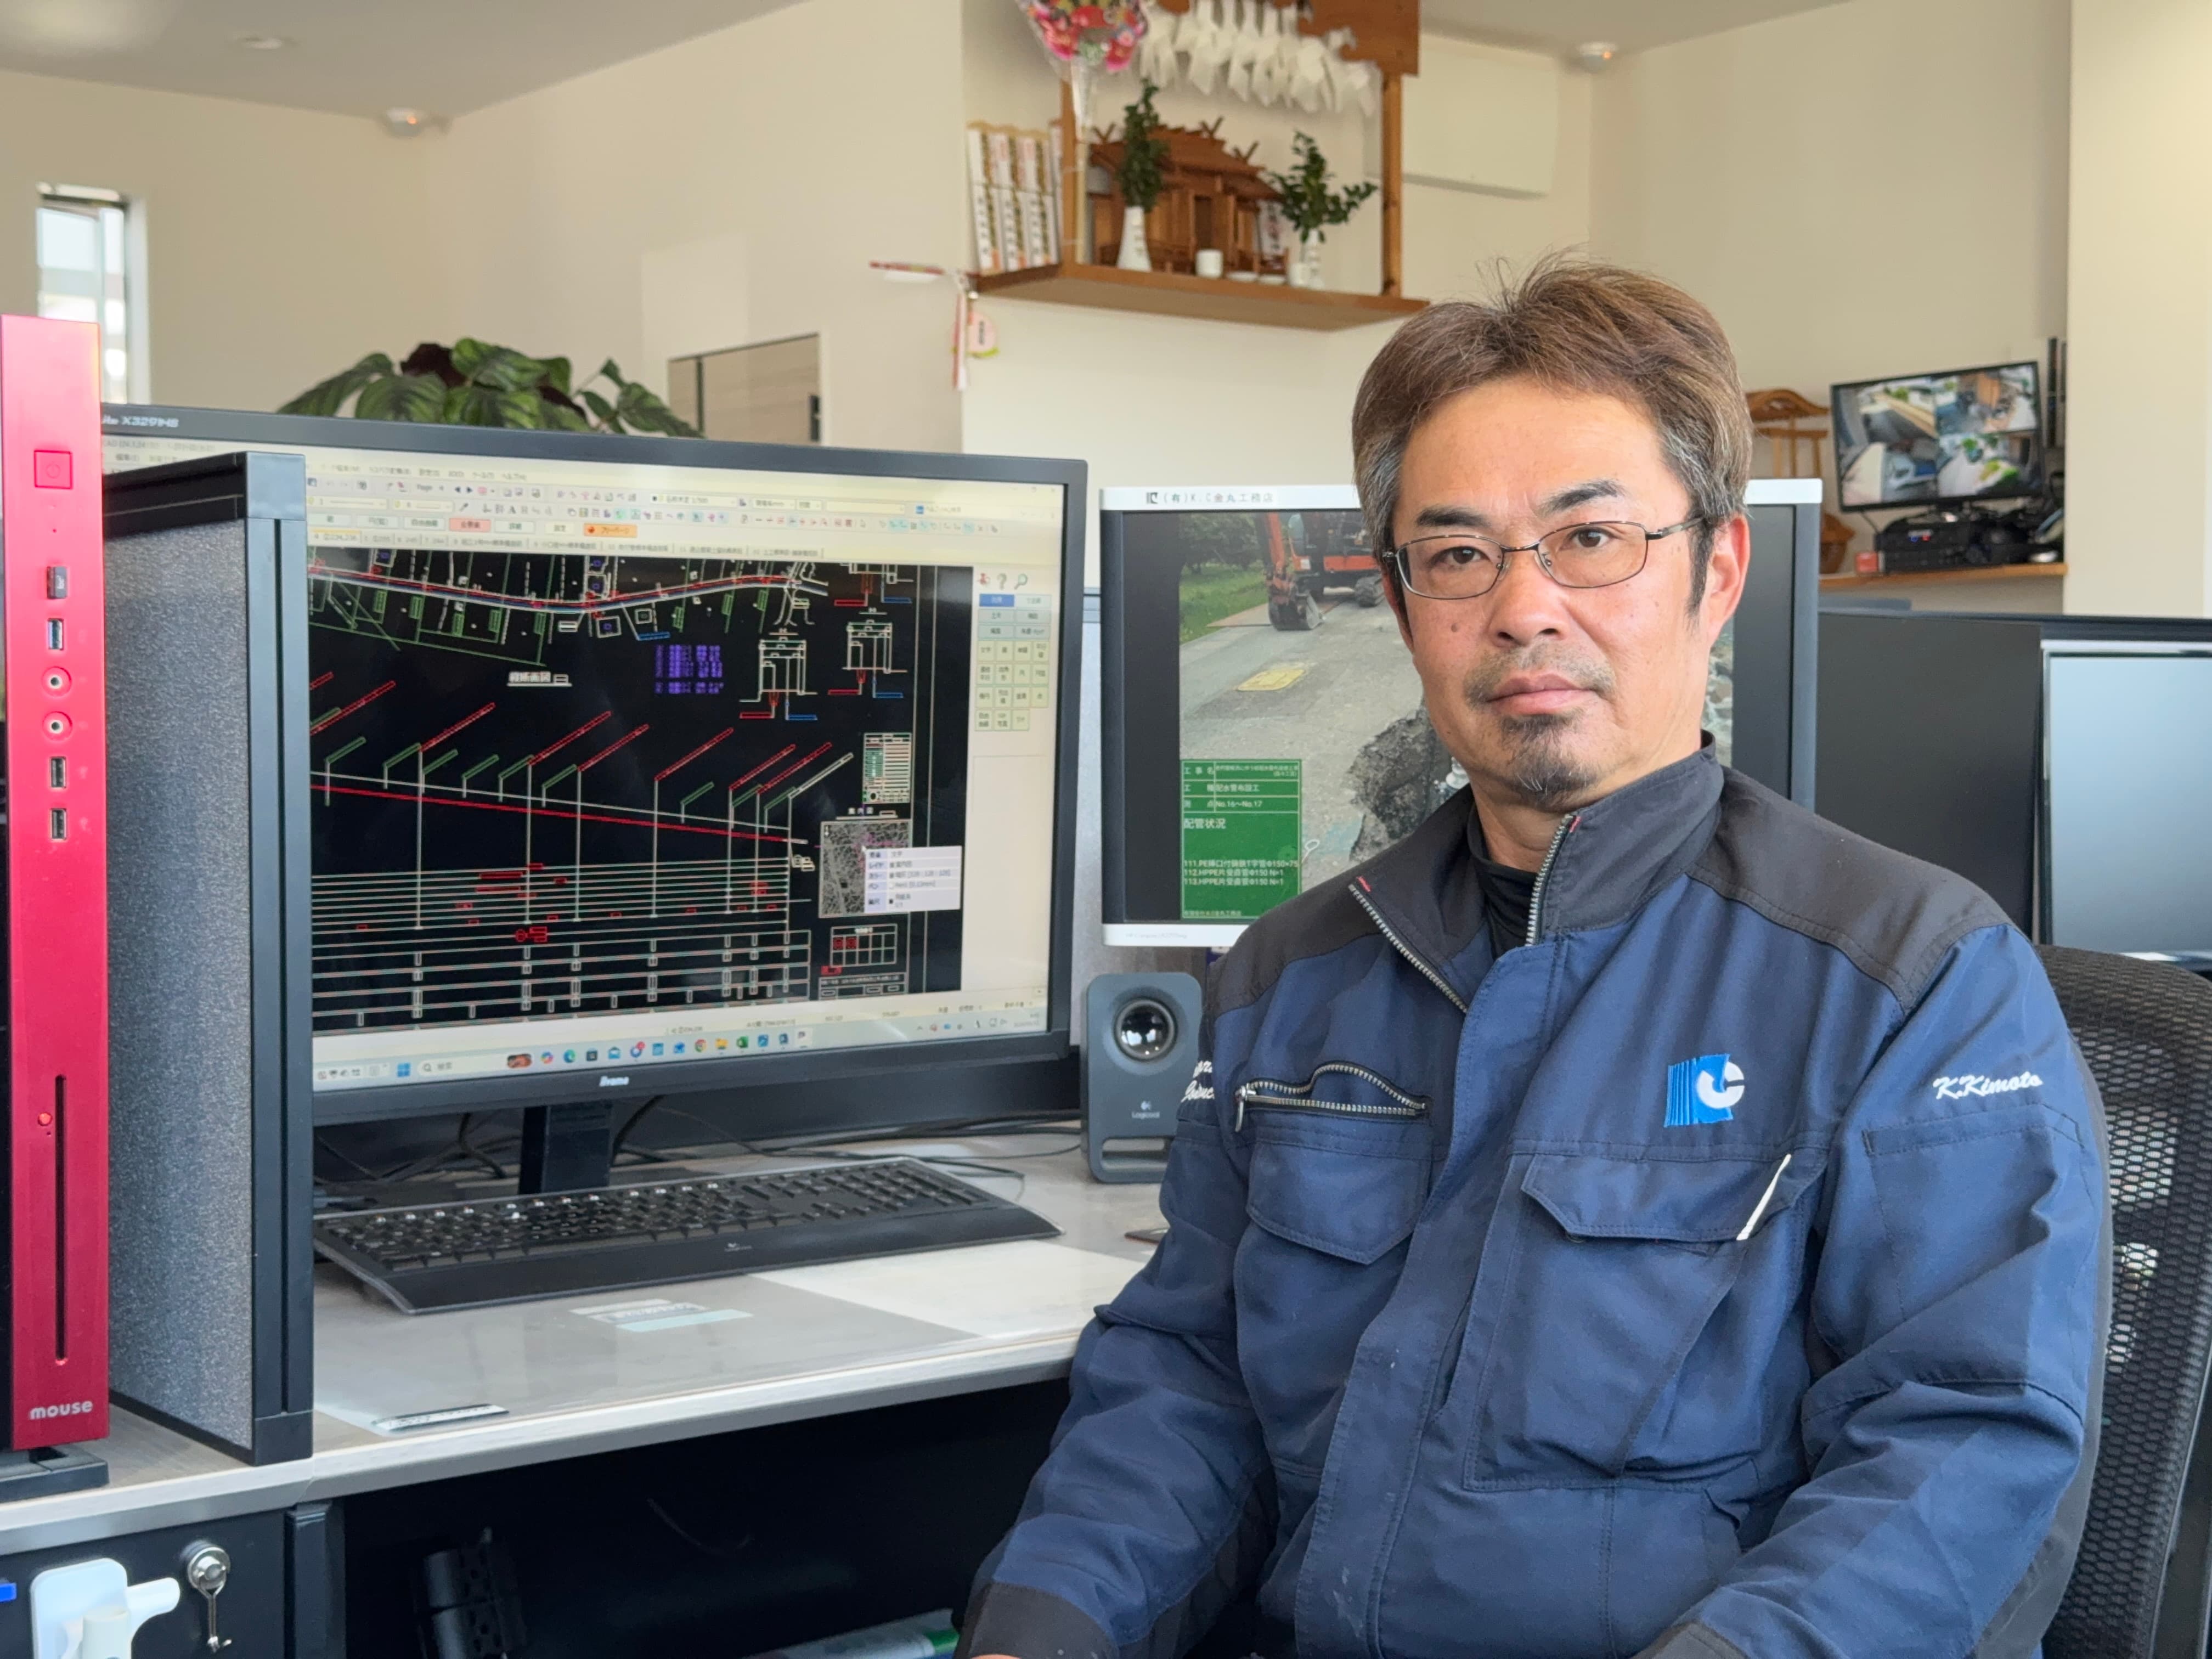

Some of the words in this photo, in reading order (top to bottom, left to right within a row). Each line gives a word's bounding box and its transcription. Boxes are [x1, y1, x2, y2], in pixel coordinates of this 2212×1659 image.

[1183, 817, 1227, 830] 配管状況
[29, 1400, 94, 1420] mouse
